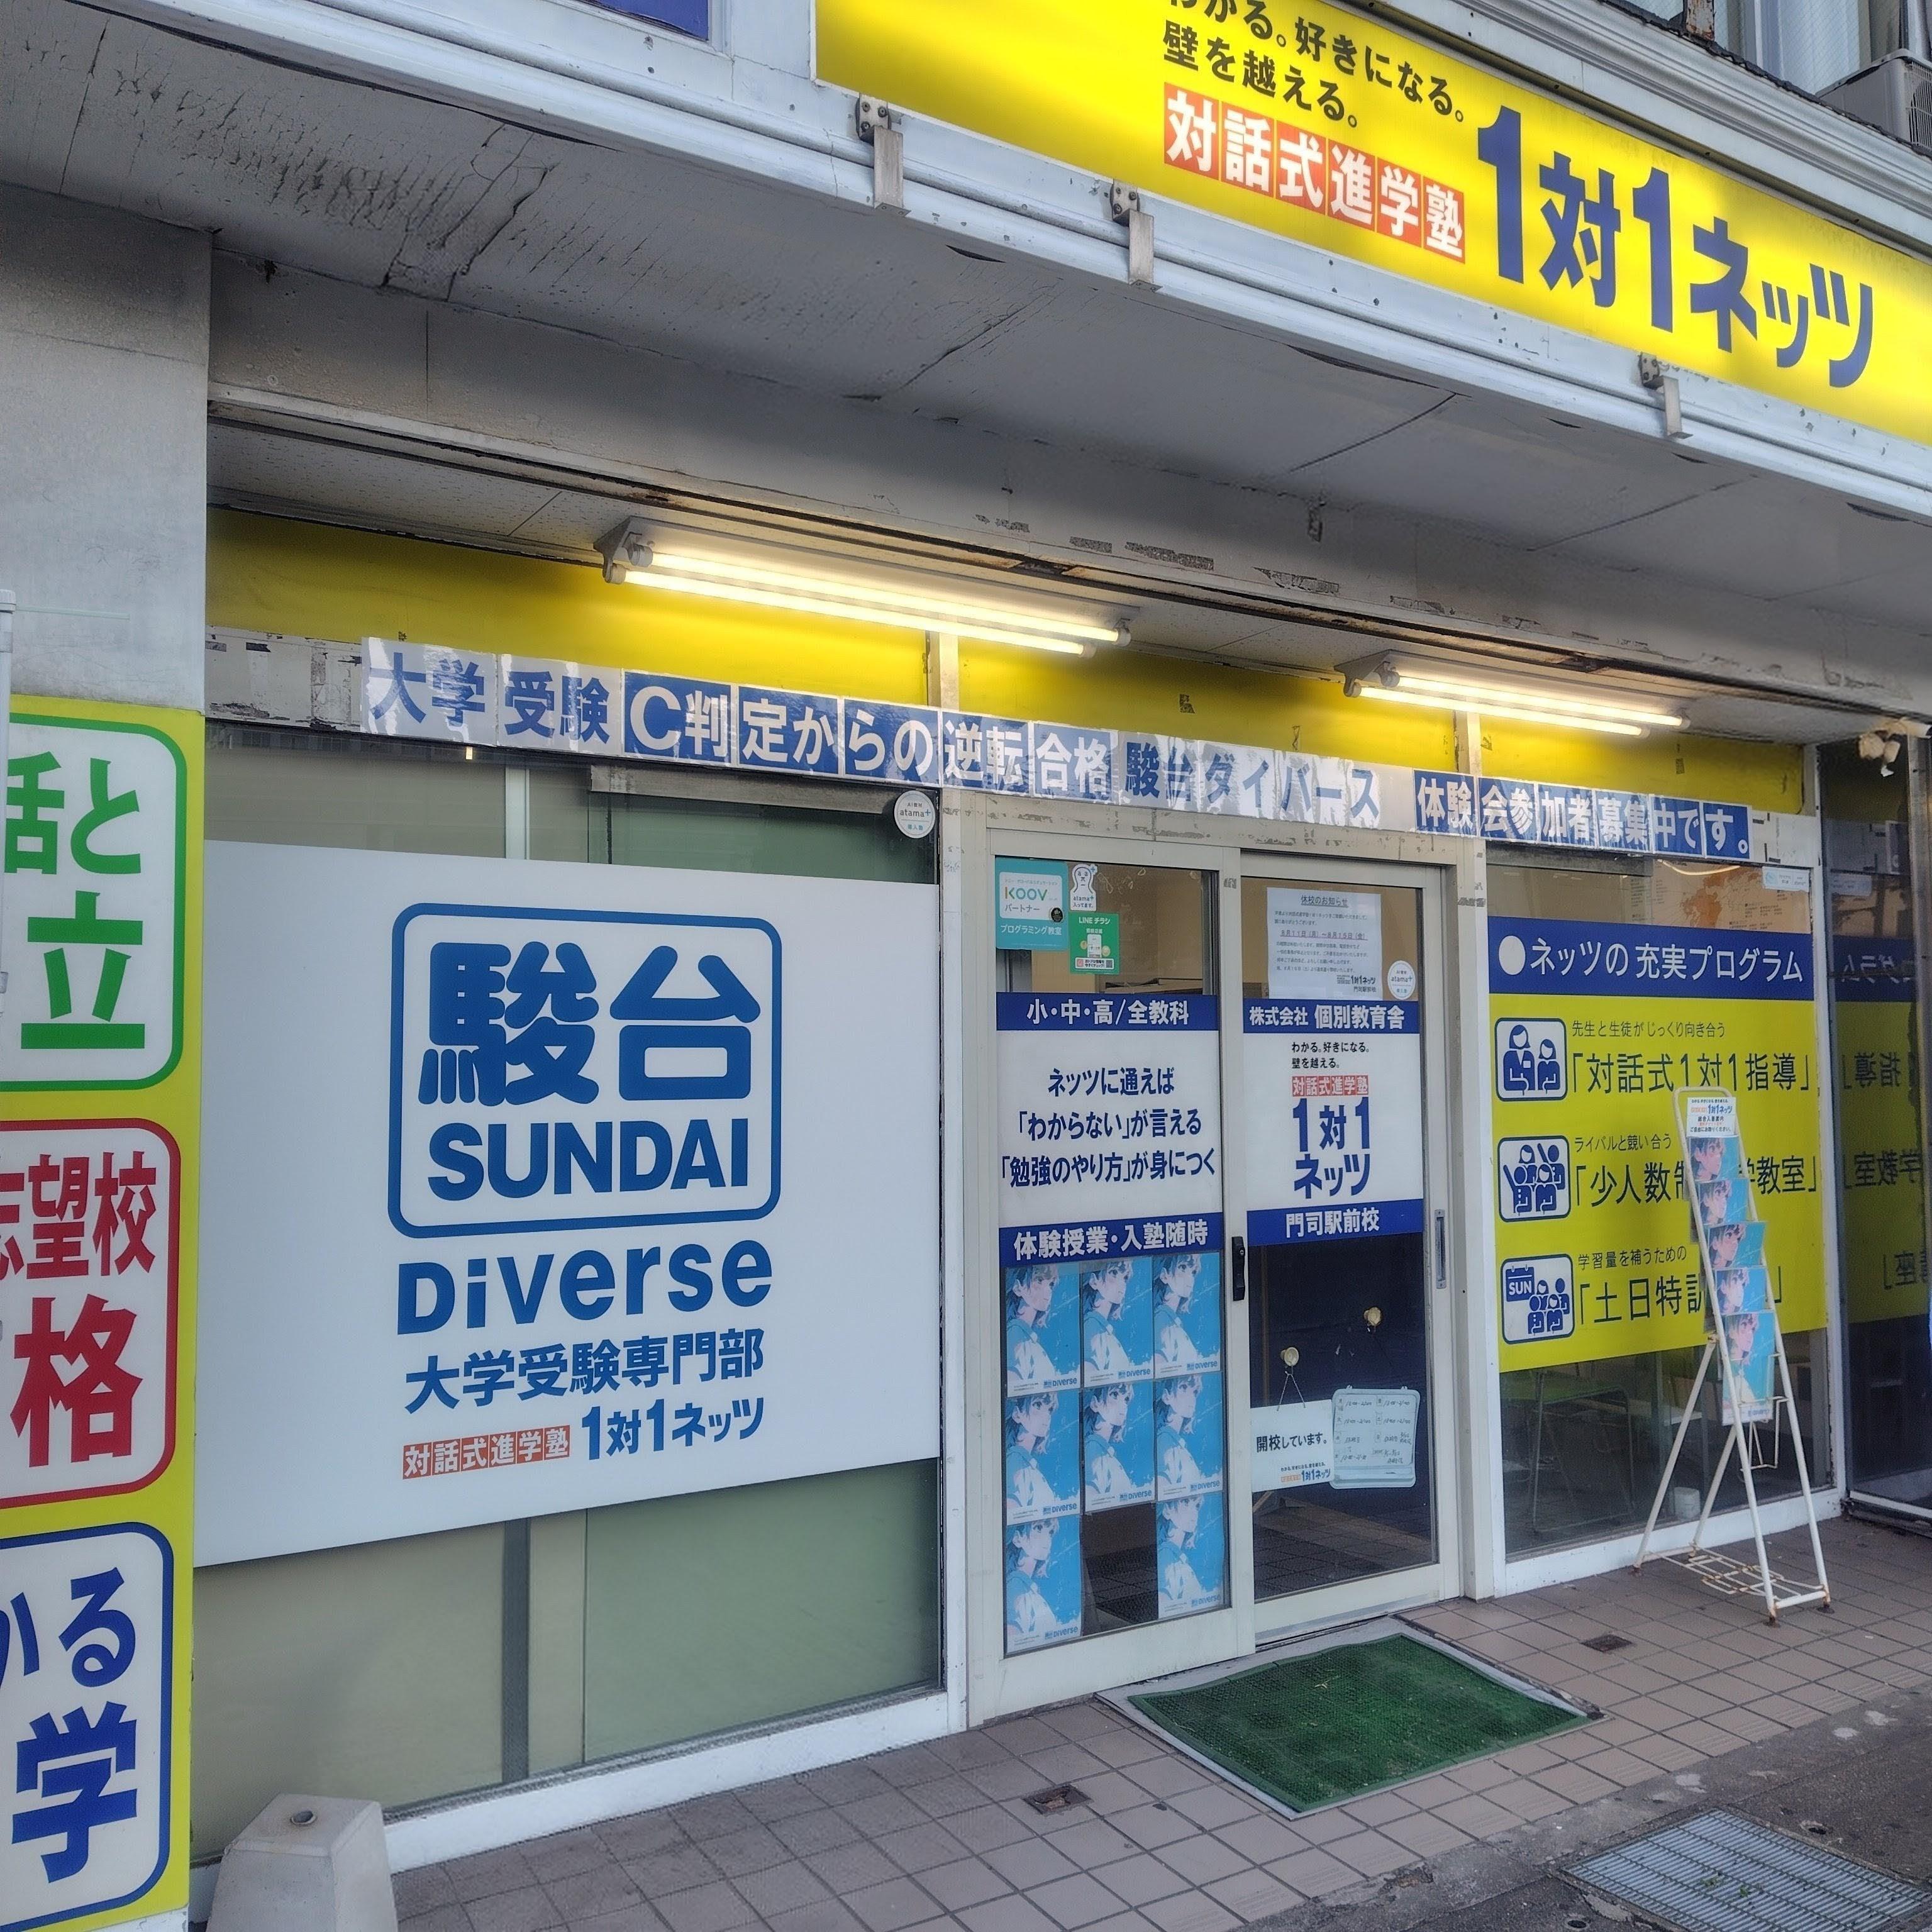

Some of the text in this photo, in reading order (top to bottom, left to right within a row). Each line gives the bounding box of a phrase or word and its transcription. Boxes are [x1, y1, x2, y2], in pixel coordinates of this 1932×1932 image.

[1163, 19, 1357, 128] 壁を越える。
[1169, 0, 1464, 122] かる。好きになる。
[1165, 89, 1463, 258] 対話式進学塾
[1478, 105, 1874, 388] 1対1ネッツ
[900, 809, 931, 818] atama+
[1004, 886, 1048, 901] KOOV
[1004, 903, 1041, 913] パートナー
[1301, 894, 1349, 906] 休校のお知らせ
[1001, 924, 1062, 936] プログラミング教室
[418, 940, 762, 1106] 駿台
[1026, 998, 1189, 1026] 小・中・高/全教科
[1249, 1004, 1405, 1030] 株式会社 個別教育舎
[1572, 1019, 1726, 1038] 先生と生徒がじっくり向き合う
[1292, 1041, 1370, 1053] わかる。好きになる。
[1292, 1057, 1340, 1069] 壁を越える。
[1048, 1066, 1175, 1097] ネッツに通えば
[1292, 1076, 1369, 1096] 対話式進学塾
[1018, 1108, 1202, 1141] 「わからない」が言える
[1574, 1133, 1672, 1153] ライバルと競い合う
[426, 1118, 750, 1202] SUNDAI
[1001, 1146, 1216, 1188] 「勉強のやり方」が身につく
[1294, 1153, 1370, 1199] ネッツ
[1285, 1208, 1380, 1238] 門司駅前校
[1014, 1218, 1209, 1261] 体験授業・入塾随時
[1578, 1245, 1687, 1271] 学習量を補うための
[1509, 1280, 1532, 1296] SUN
[10, 1293, 143, 1468] 格
[404, 1327, 765, 1414] 大学受験専門部
[402, 1396, 764, 1480] 対話式進学塾 1対1ネッツ
[1256, 1432, 1328, 1453] 開校しています。
[11, 1701, 138, 1884] 学
